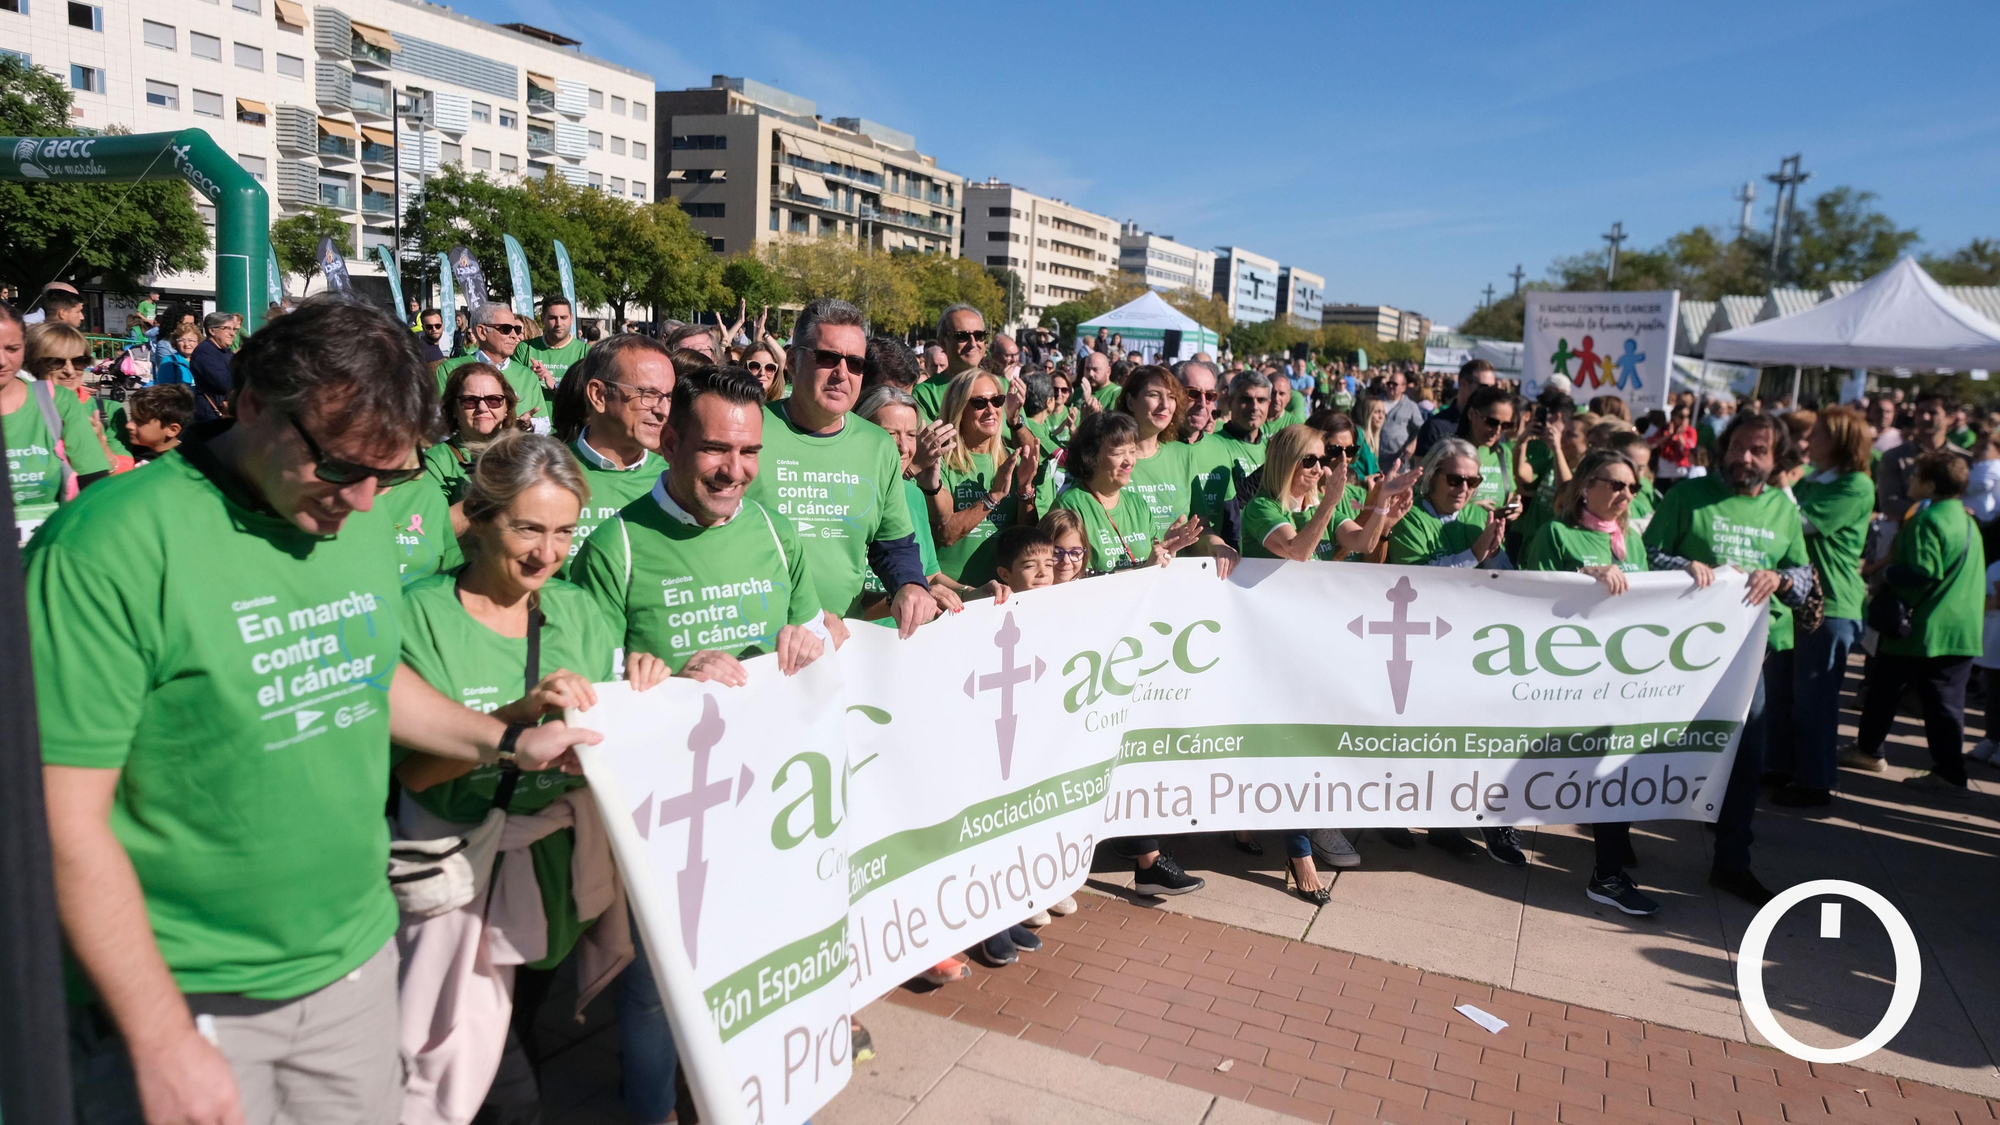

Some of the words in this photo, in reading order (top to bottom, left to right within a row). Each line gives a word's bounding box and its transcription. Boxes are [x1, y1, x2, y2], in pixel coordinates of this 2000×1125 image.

[43, 139, 96, 158] aecc
[182, 161, 222, 199] aecc
[6, 444, 49, 457] archa
[9, 471, 46, 482] ncer
[777, 467, 798, 481] En
[803, 470, 860, 484] marcha
[778, 485, 828, 498] contra
[1137, 482, 1176, 493] marcha
[778, 500, 792, 514] el
[797, 501, 850, 516] cáncer
[1150, 504, 1173, 514] ncer
[1712, 520, 1729, 532] En
[1732, 524, 1775, 540] marcha
[1712, 533, 1751, 546] contra
[1711, 543, 1724, 553] el
[1727, 546, 1767, 560] cáncer
[1106, 557, 1116, 568] el
[661, 575, 693, 586] Córdoba
[663, 588, 695, 607] En
[701, 577, 772, 602] marcha
[237, 614, 284, 644] En
[287, 591, 378, 632] marcha
[668, 604, 738, 627] contra
[670, 629, 691, 649] el
[697, 621, 767, 645] cáncer
[251, 633, 340, 675] contra
[1472, 621, 1726, 676] aecc
[257, 675, 285, 707] el
[290, 653, 376, 697] cáncer
[1511, 681, 1583, 701] Contra
[1593, 682, 1611, 699] el
[1620, 680, 1685, 699] Cáncer
[1152, 734, 1171, 755] el
[1176, 733, 1244, 754] Cáncer
[1337, 731, 1457, 753] Asociación
[1465, 732, 1562, 758] Española
[1567, 731, 1635, 752] Contra
[1640, 727, 1658, 748] el
[959, 789, 1059, 842] Asociación
[1061, 767, 1111, 805] Españ
[1103, 780, 1193, 823] unta
[1210, 770, 1435, 814] Provincial
[1450, 770, 1509, 812] de
[882, 898, 929, 963] de
[937, 831, 1094, 930] Córdoba
